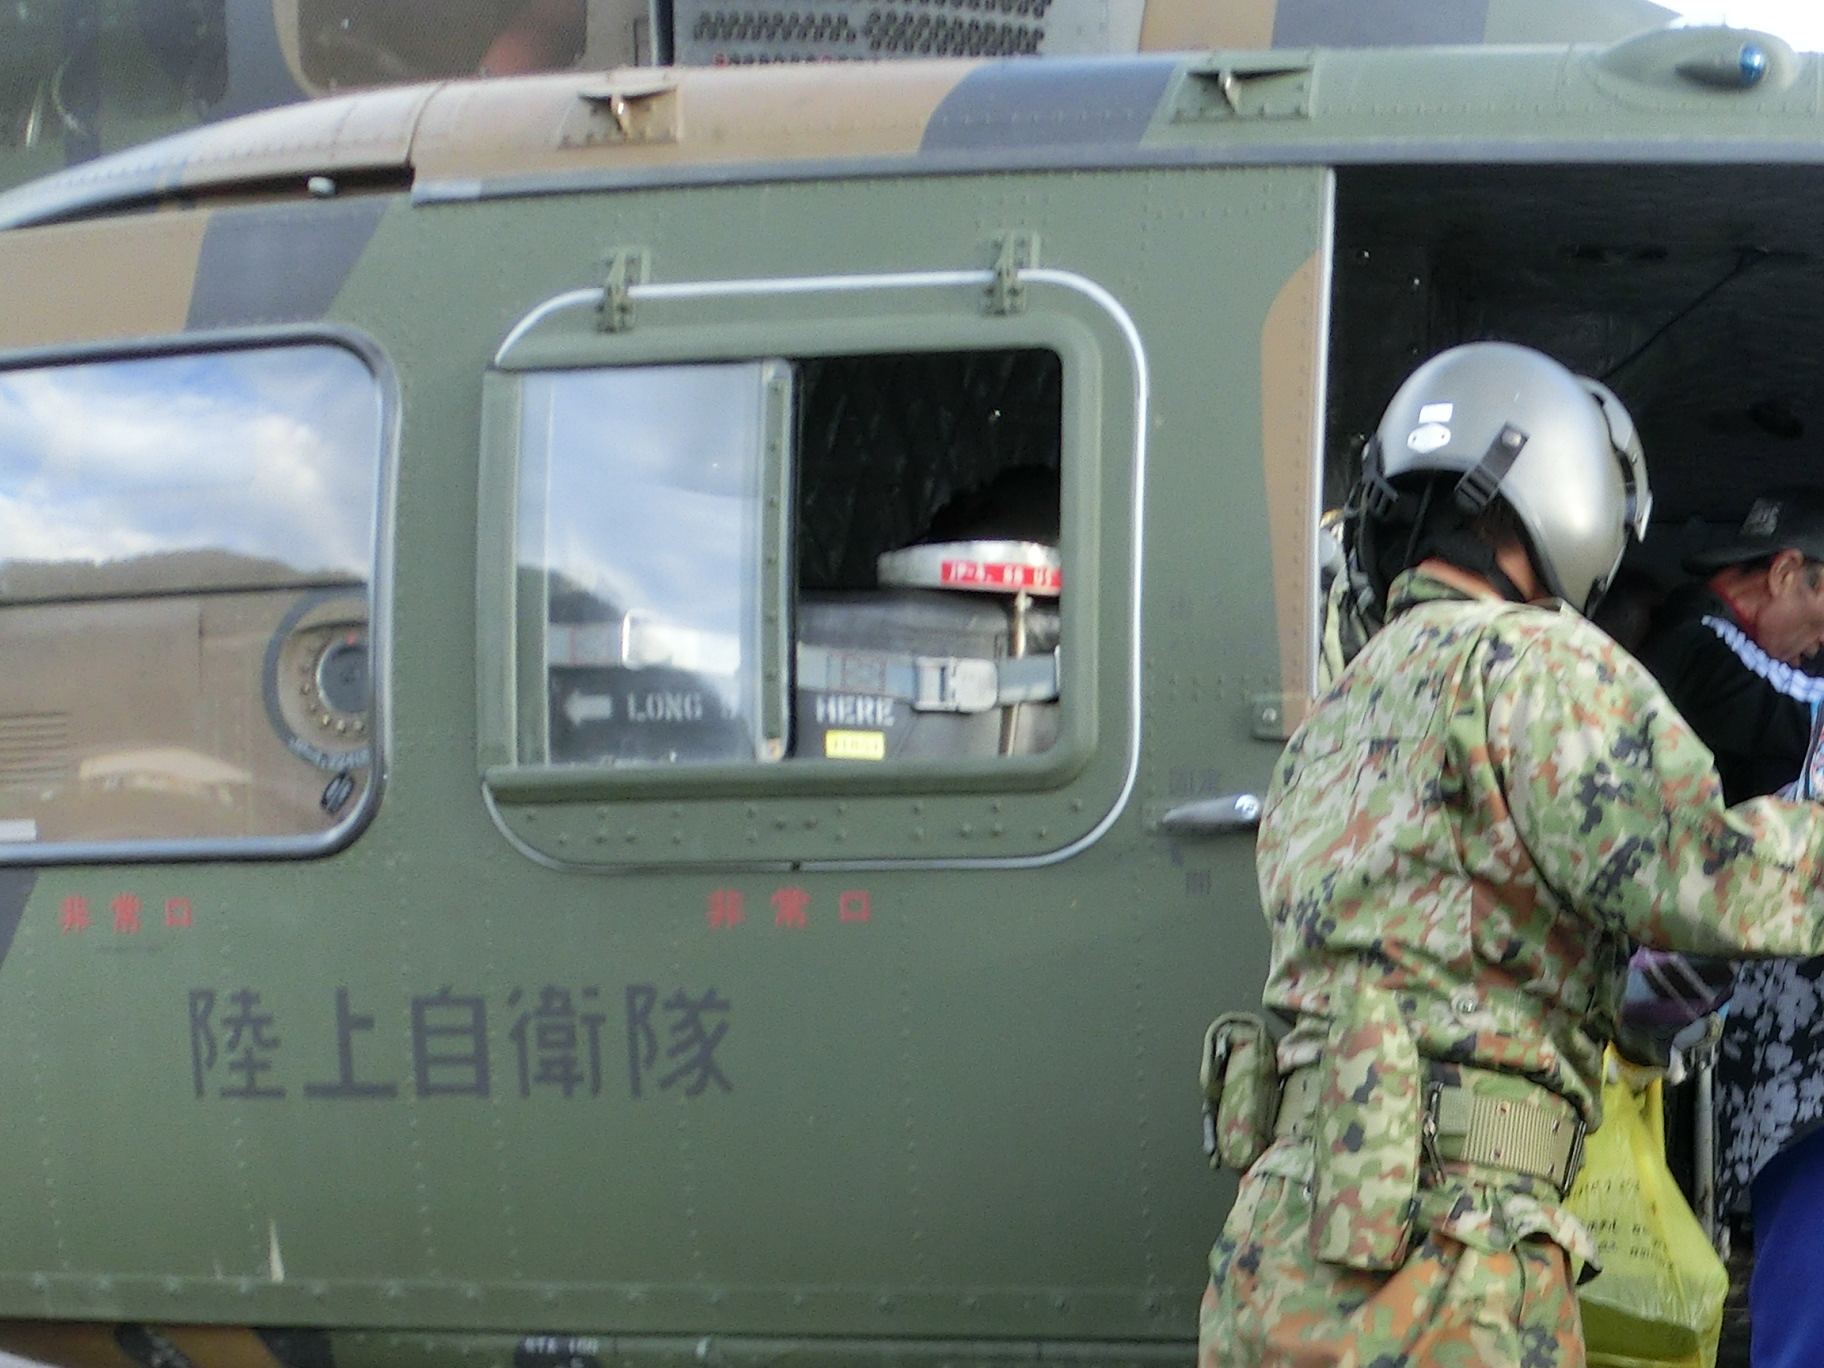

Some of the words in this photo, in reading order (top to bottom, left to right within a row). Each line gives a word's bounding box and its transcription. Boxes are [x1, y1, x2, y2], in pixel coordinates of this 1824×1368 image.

[60, 896, 192, 932] 非常口
[706, 888, 874, 929] 非常口
[188, 986, 735, 1101] 陸上自衛隊
